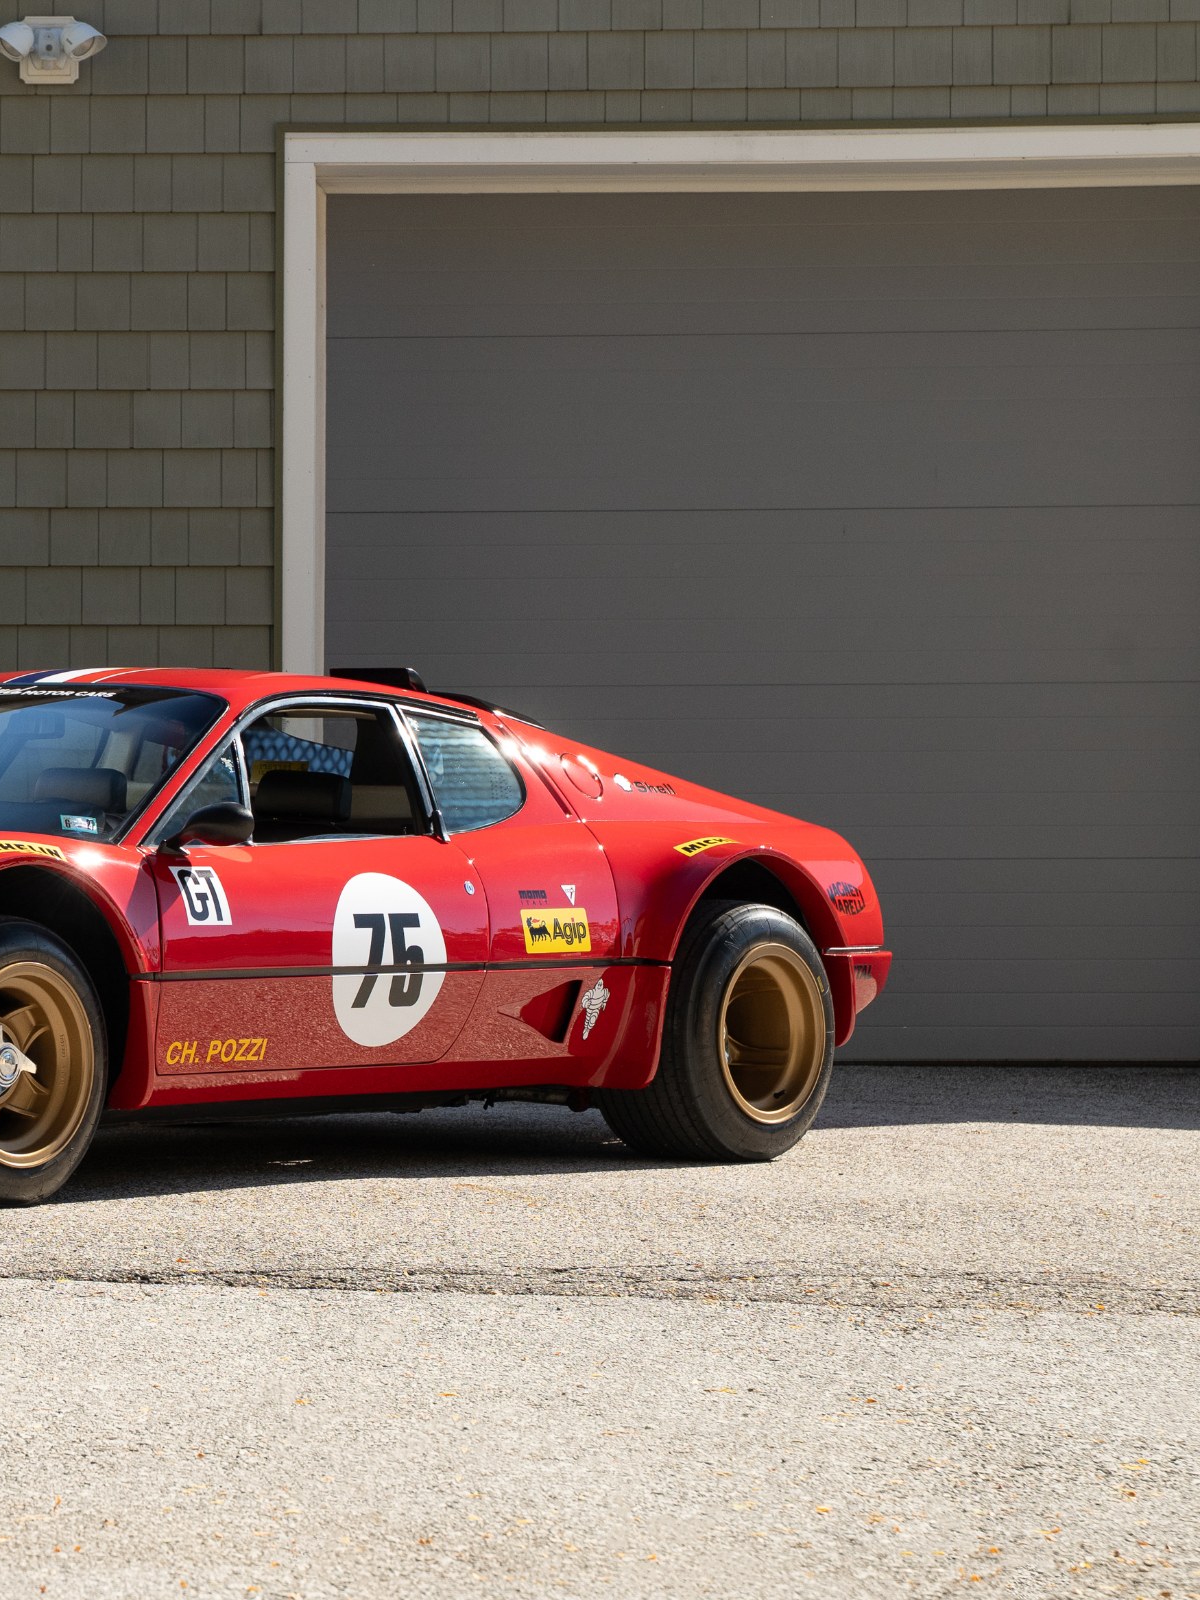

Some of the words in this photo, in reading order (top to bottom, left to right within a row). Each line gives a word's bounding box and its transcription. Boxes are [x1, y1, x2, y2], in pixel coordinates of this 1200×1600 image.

[75, 690, 117, 698] CARS
[633, 781, 677, 795] Shell
[176, 869, 224, 921] GT
[553, 917, 587, 945] Agip
[351, 912, 425, 1008] 75
[166, 1040, 200, 1064] CH.
[206, 1038, 268, 1062] POZZI
